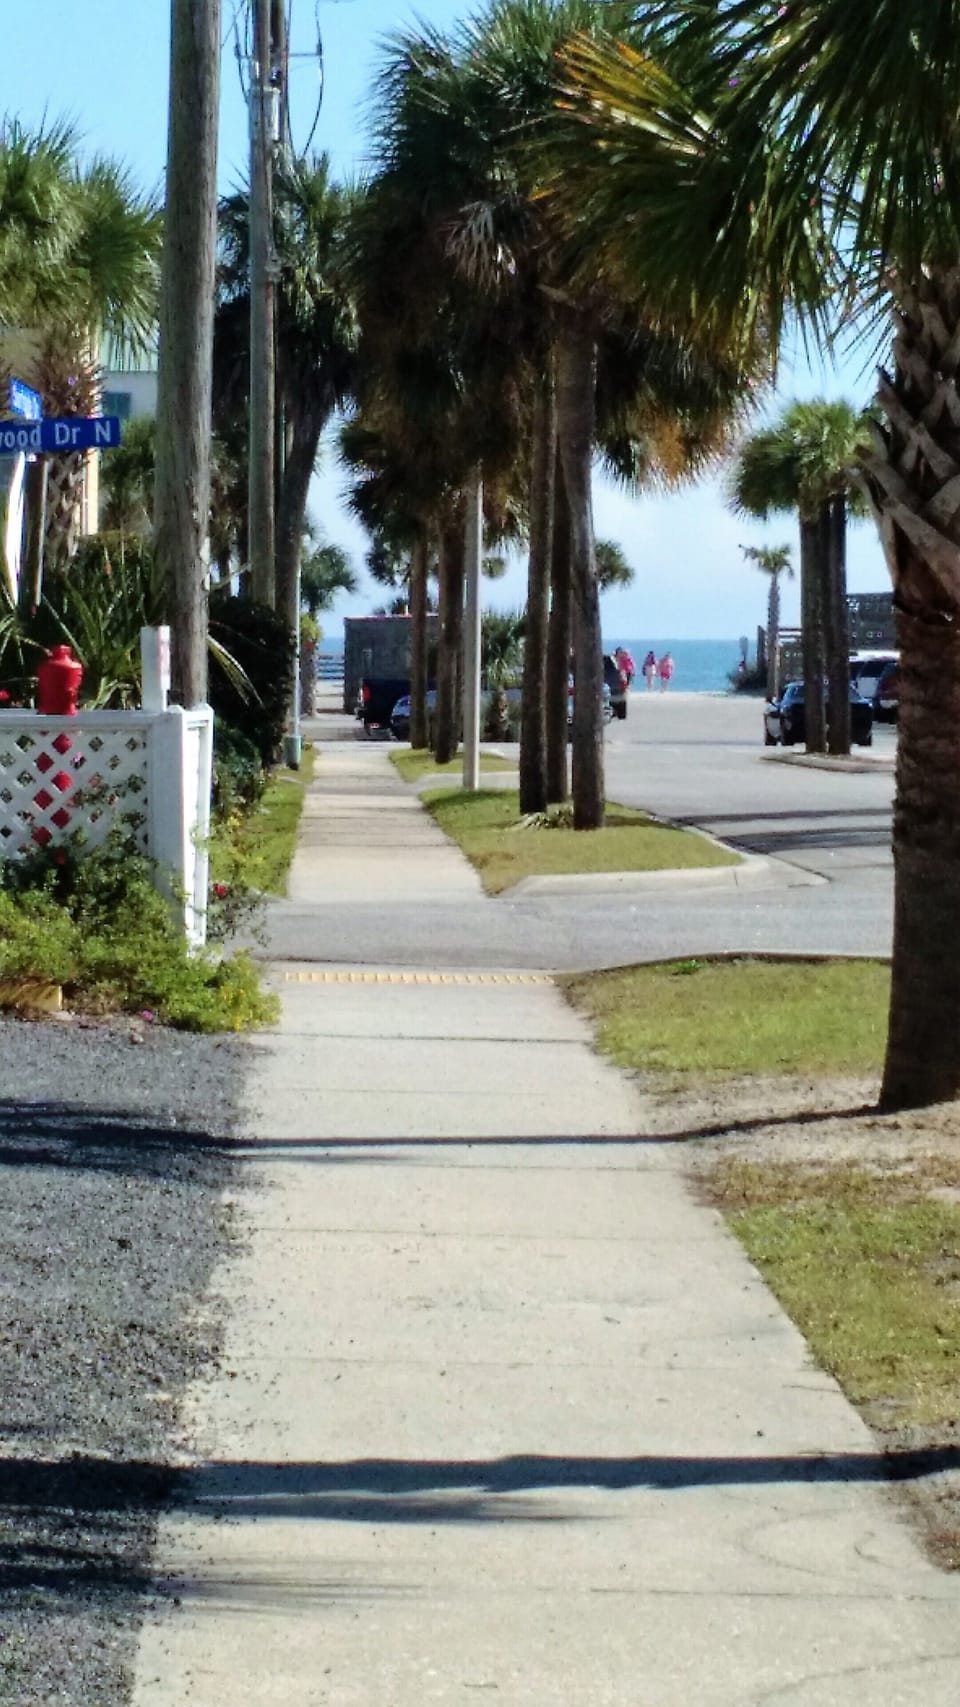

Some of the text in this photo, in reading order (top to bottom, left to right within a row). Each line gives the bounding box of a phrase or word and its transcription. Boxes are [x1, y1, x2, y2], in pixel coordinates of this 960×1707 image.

[0, 420, 111, 448] ood Dr N
